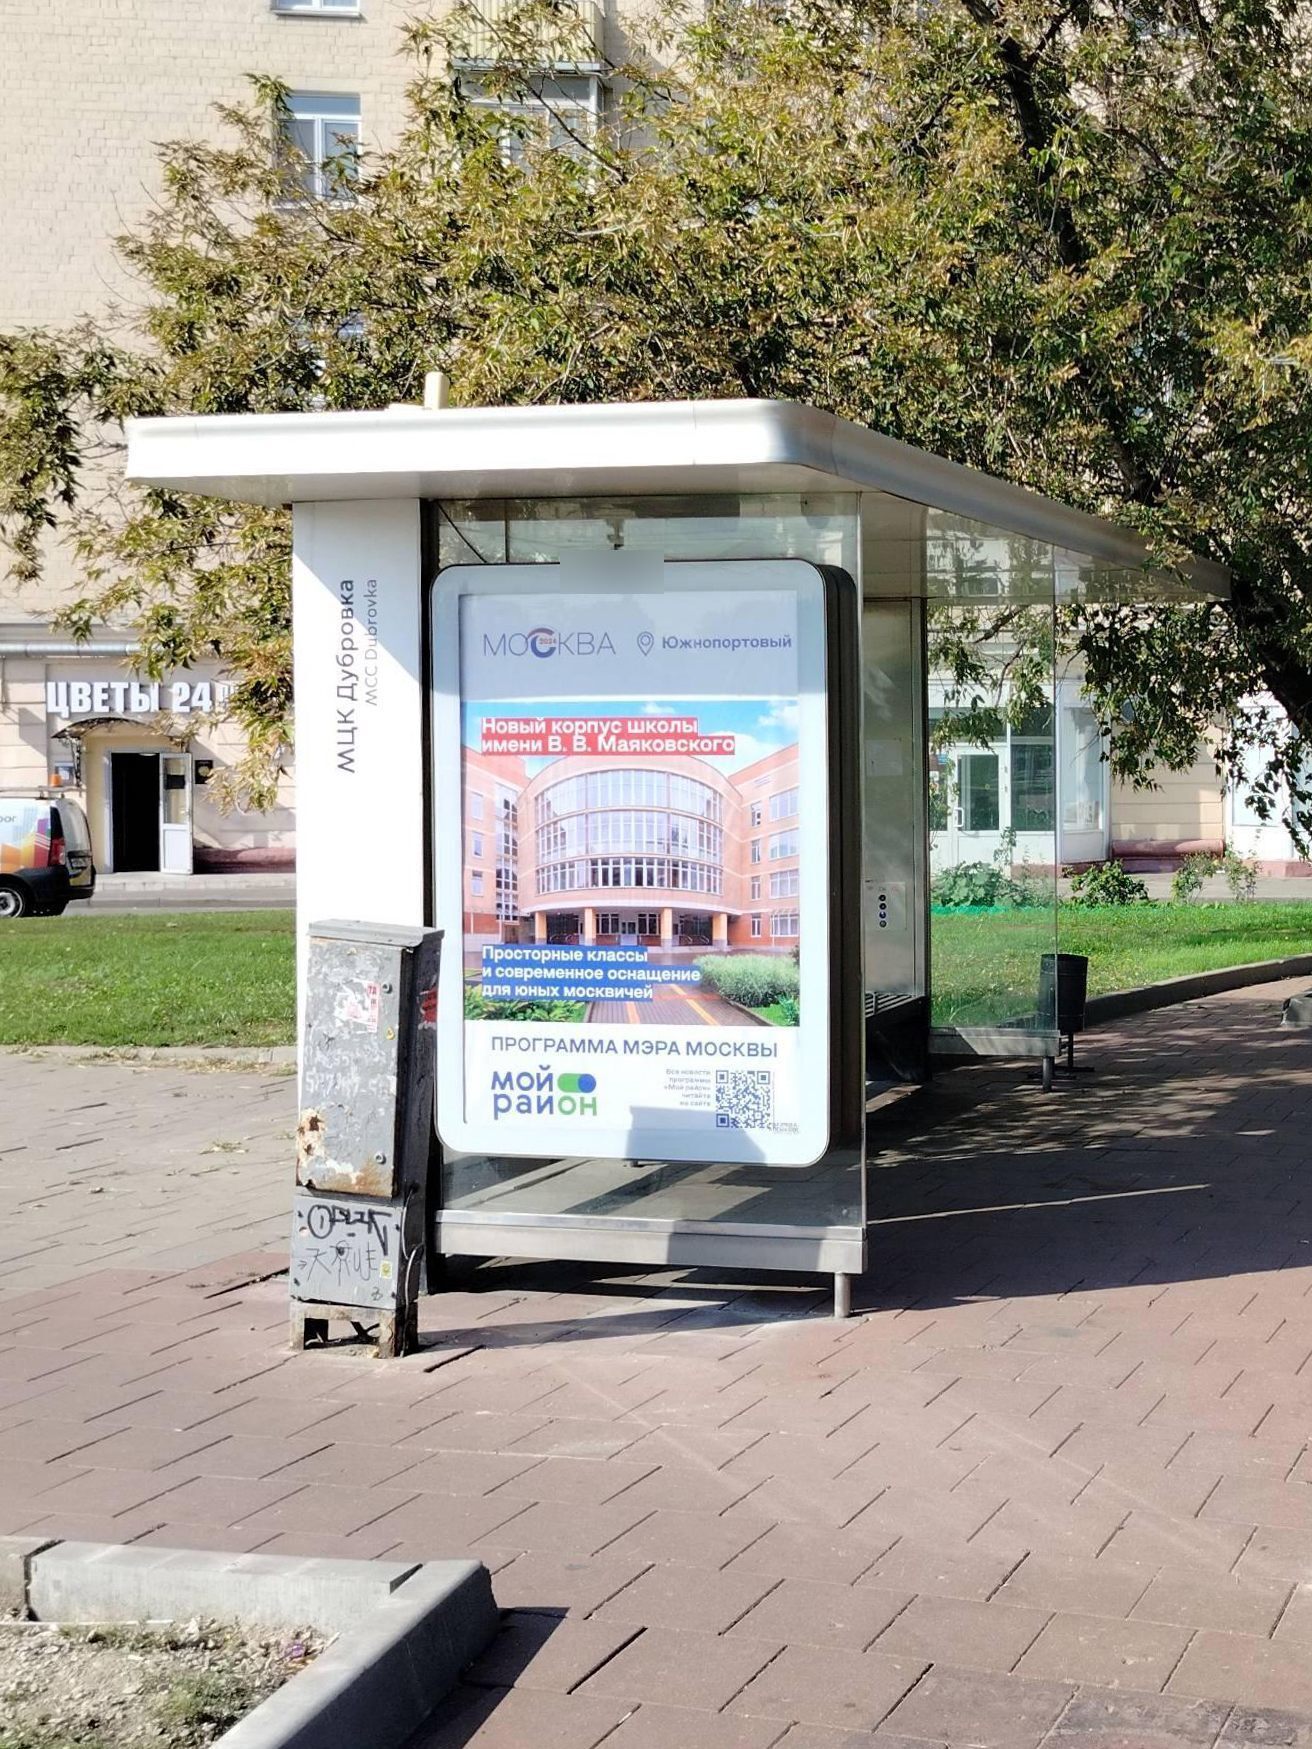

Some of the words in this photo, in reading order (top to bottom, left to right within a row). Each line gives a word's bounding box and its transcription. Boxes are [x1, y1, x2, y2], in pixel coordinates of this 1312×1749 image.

[363, 579, 378, 660] Dubrovka
[336, 579, 359, 702] Дубровка
[482, 627, 617, 658] МОСКВА
[661, 634, 792, 651] Южнопортовый
[364, 665, 378, 706] MCC
[46, 681, 160, 719] ЦВЕТЫ
[171, 681, 213, 714] 24
[336, 708, 358, 774] МЦК
[482, 717, 546, 735] Новый
[551, 719, 623, 741] корпус
[627, 718, 699, 734] школы
[482, 738, 543, 752] имени
[548, 735, 568, 752] В.
[573, 736, 592, 752] В.
[598, 735, 736, 753] Маяковского
[482, 945, 584, 963] Просторные
[587, 948, 649, 963] классы
[482, 965, 492, 978] и
[495, 966, 604, 982] современное
[608, 969, 702, 983] оснащение
[482, 983, 511, 997] для
[515, 984, 560, 998] юных
[564, 984, 654, 999] москвичей
[491, 1036, 619, 1055] ПРОГРАММА
[623, 1039, 681, 1057] МЭРА
[686, 1041, 778, 1058] МОСКВЫ
